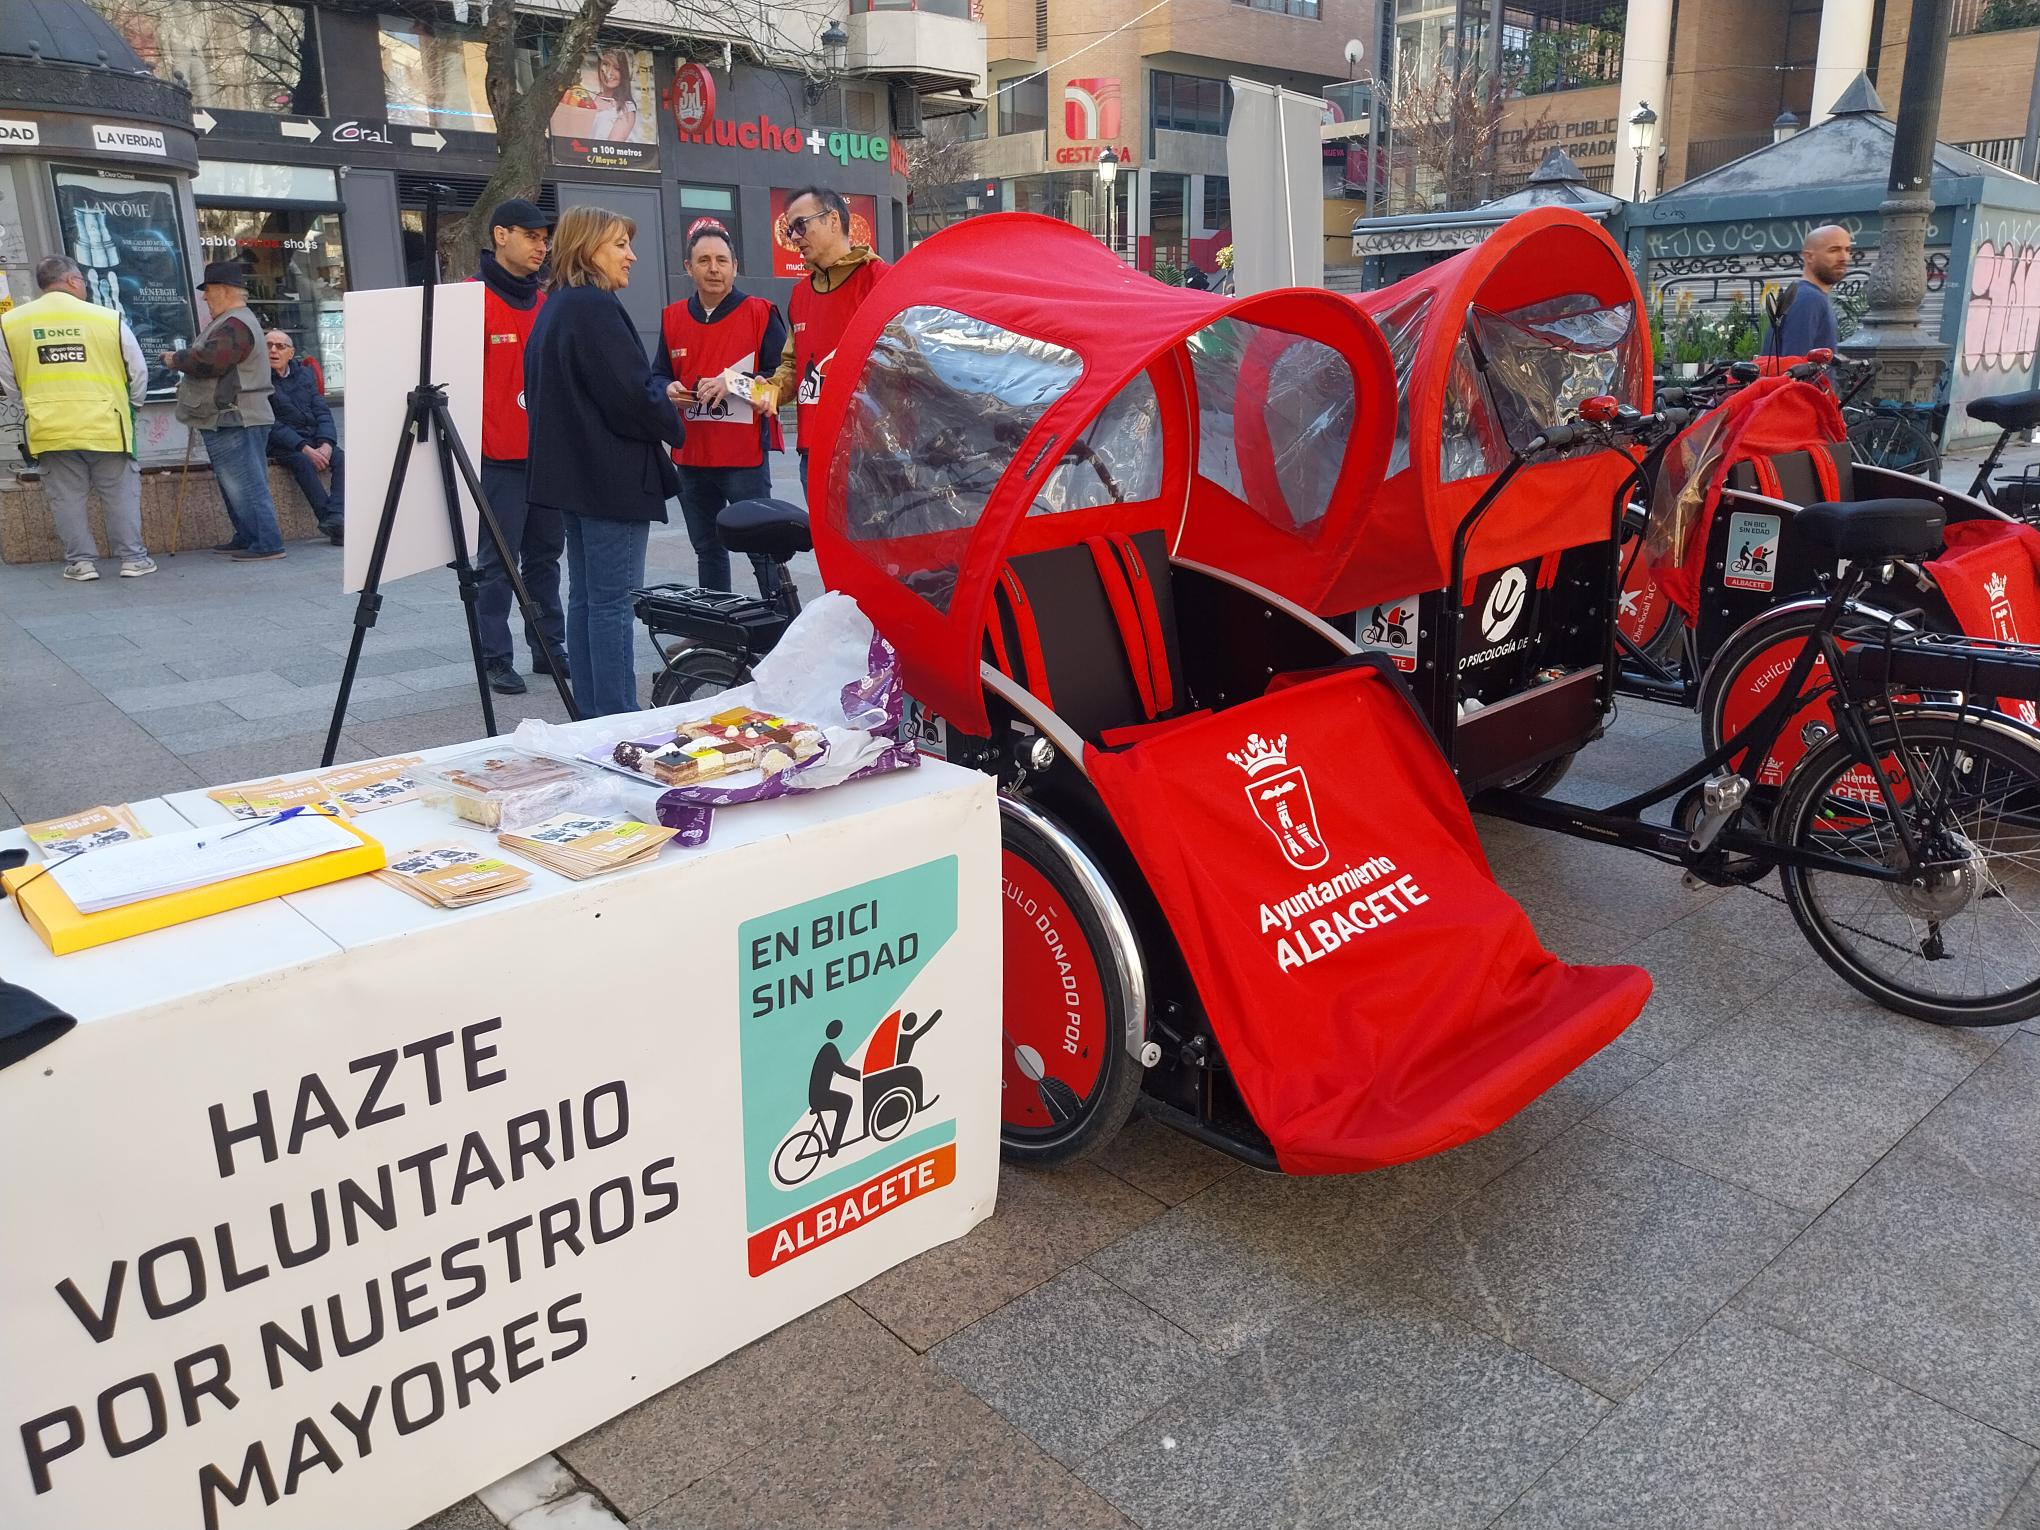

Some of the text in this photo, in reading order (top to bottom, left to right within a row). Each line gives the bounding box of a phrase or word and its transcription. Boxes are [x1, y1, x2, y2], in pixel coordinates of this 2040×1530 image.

[97, 131, 163, 149] LA VERDAD
[332, 121, 394, 144] Coral
[1566, 118, 1618, 138] PUBLIC
[601, 145, 615, 155] 100
[616, 147, 642, 157] metros
[828, 131, 889, 166] que
[283, 238, 318, 250] shoes
[786, 263, 805, 271] much
[48, 328, 81, 337] ONCE
[49, 346, 67, 354] grupo
[50, 352, 84, 362] ONCE
[1731, 579, 1766, 589] ALBACETE
[1637, 601, 1651, 626] Social
[1632, 625, 1645, 643] Obra
[1466, 638, 1516, 668] PSICOLOGÍA
[1516, 636, 1529, 651] DE
[1259, 856, 1397, 934] Ayuntamiento
[752, 899, 878, 971] EN BICI
[1276, 873, 1431, 974] ALBACETE
[752, 932, 919, 1019] SIN EDAD
[1035, 914, 1080, 1006] DONADO
[1062, 1011, 1081, 1055] POR
[208, 1016, 508, 1179] HAZTE
[55, 1080, 630, 1344] VOLUNTARIO
[771, 1158, 935, 1262] ALBACETE
[20, 1156, 680, 1495] POR NUESTROS
[198, 1292, 588, 1530] MAYORES
